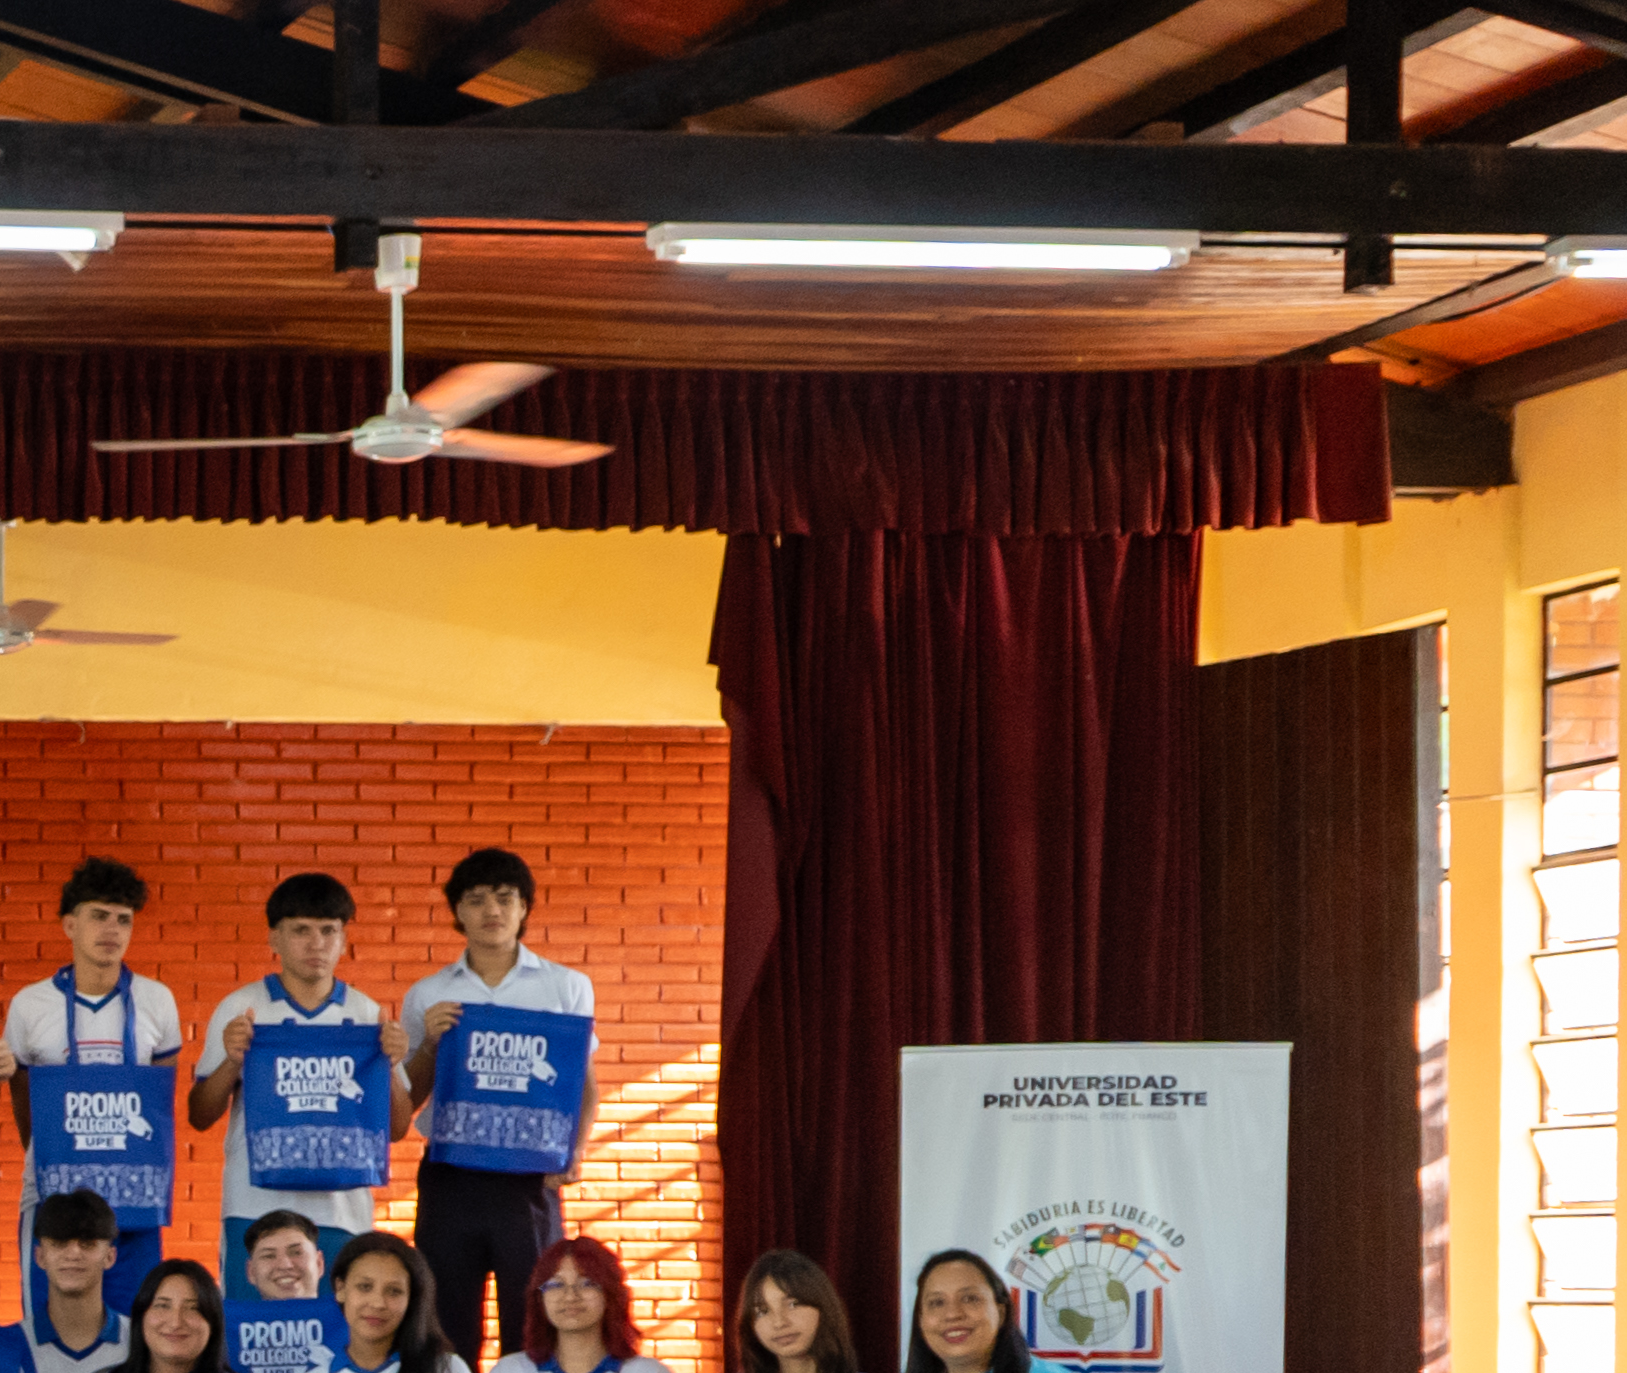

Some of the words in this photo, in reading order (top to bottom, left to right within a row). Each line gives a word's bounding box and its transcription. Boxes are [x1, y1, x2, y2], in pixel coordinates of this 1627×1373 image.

[471, 1030, 548, 1059] PROMO
[276, 1055, 355, 1081] PROMO
[487, 1076, 518, 1090] UPE
[1013, 1075, 1177, 1090] UNIVERSIDAD
[65, 1091, 141, 1117] PROMO
[298, 1097, 328, 1110] UPE
[984, 1093, 1089, 1108] PRIVADA
[1098, 1093, 1143, 1107] DEL
[1150, 1092, 1208, 1107] ESTE
[84, 1136, 115, 1148] UPE
[1088, 1200, 1106, 1214] ES
[1111, 1202, 1186, 1249] LIBERTAD
[240, 1319, 323, 1348] PROMO
